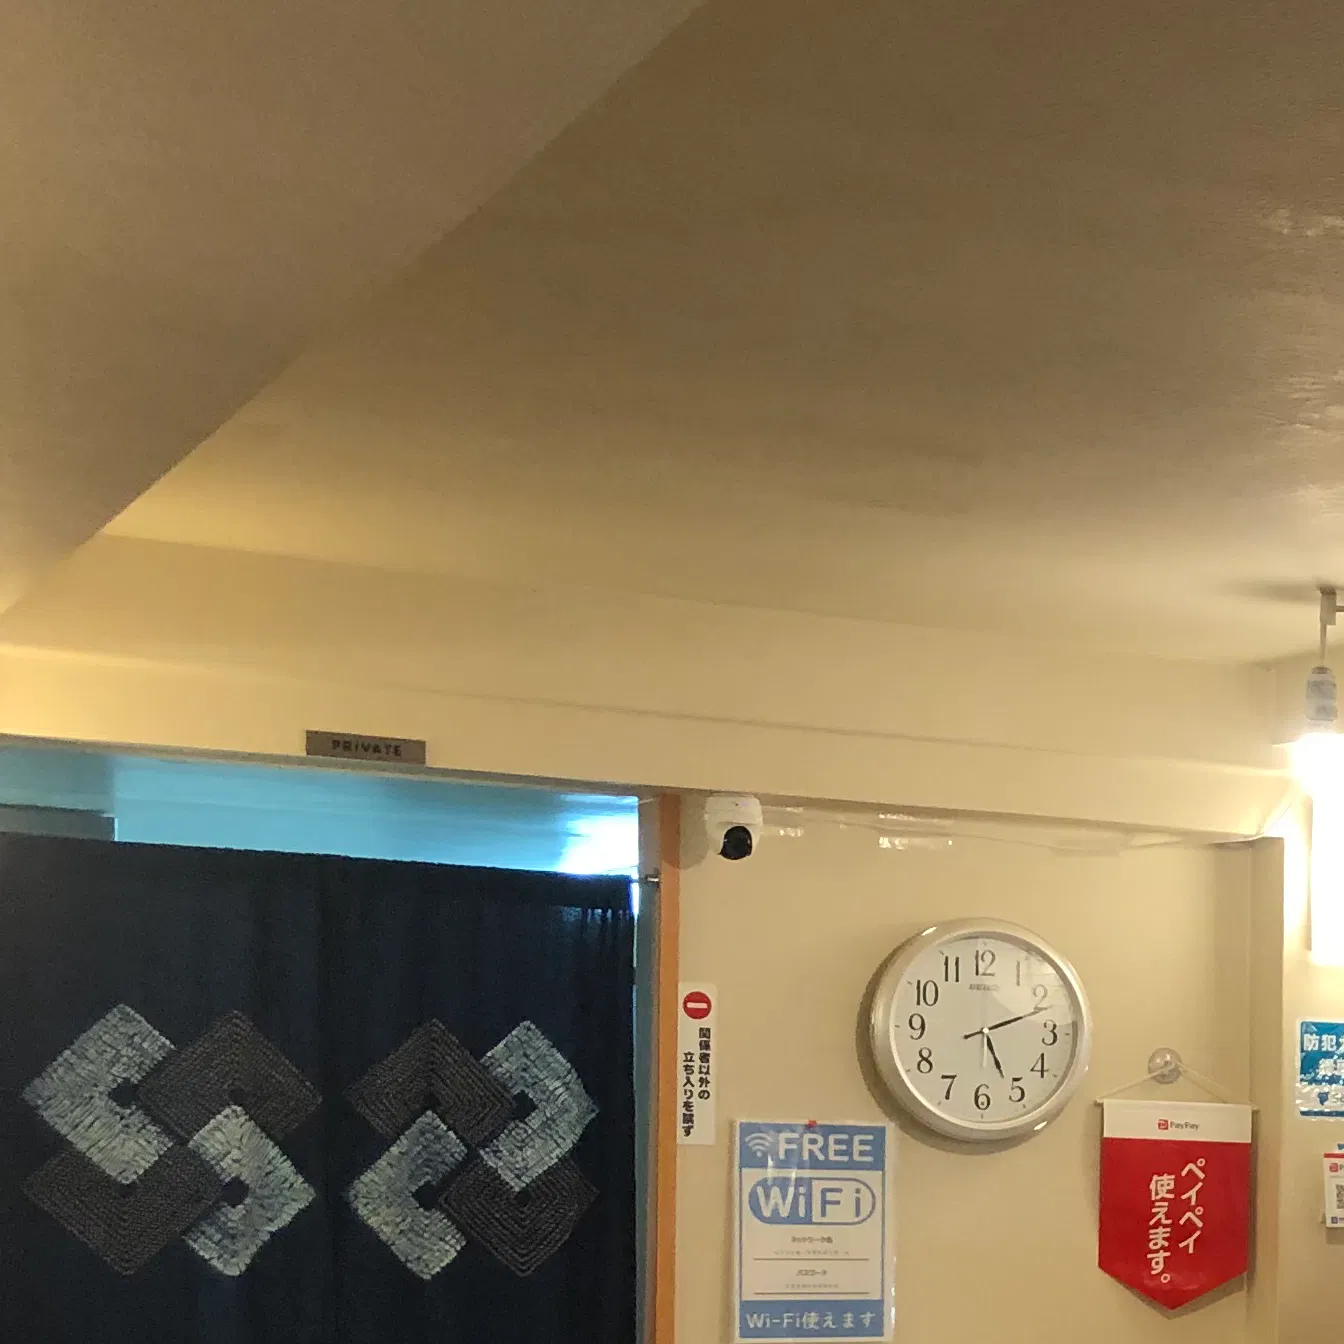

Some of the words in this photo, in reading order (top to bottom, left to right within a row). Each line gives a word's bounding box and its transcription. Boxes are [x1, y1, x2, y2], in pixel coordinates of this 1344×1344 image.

[331, 739, 402, 756] PRIVATE
[944, 956, 959, 982] 11
[975, 949, 995, 976] 12
[1016, 960, 1020, 987] 1
[916, 980, 939, 1006] 10
[1032, 984, 1048, 1010] 2
[908, 1013, 926, 1040] 9
[1041, 1019, 1058, 1046] 3
[698, 1027, 712, 1101] 関係者以外の
[916, 1047, 933, 1074] 8
[1029, 1052, 1049, 1078] 4
[682, 1051, 696, 1138] 立ち入りを禁ず
[940, 1074, 958, 1100] 7
[973, 1084, 991, 1110] 6
[1008, 1076, 1026, 1103] 5
[1170, 1119, 1200, 1131] PayPay
[778, 1132, 874, 1162] FREE
[1179, 1157, 1206, 1254] ペイペイ
[1147, 1173, 1176, 1284] 使えます。
[745, 1310, 876, 1330] Wi-Fi使えます
